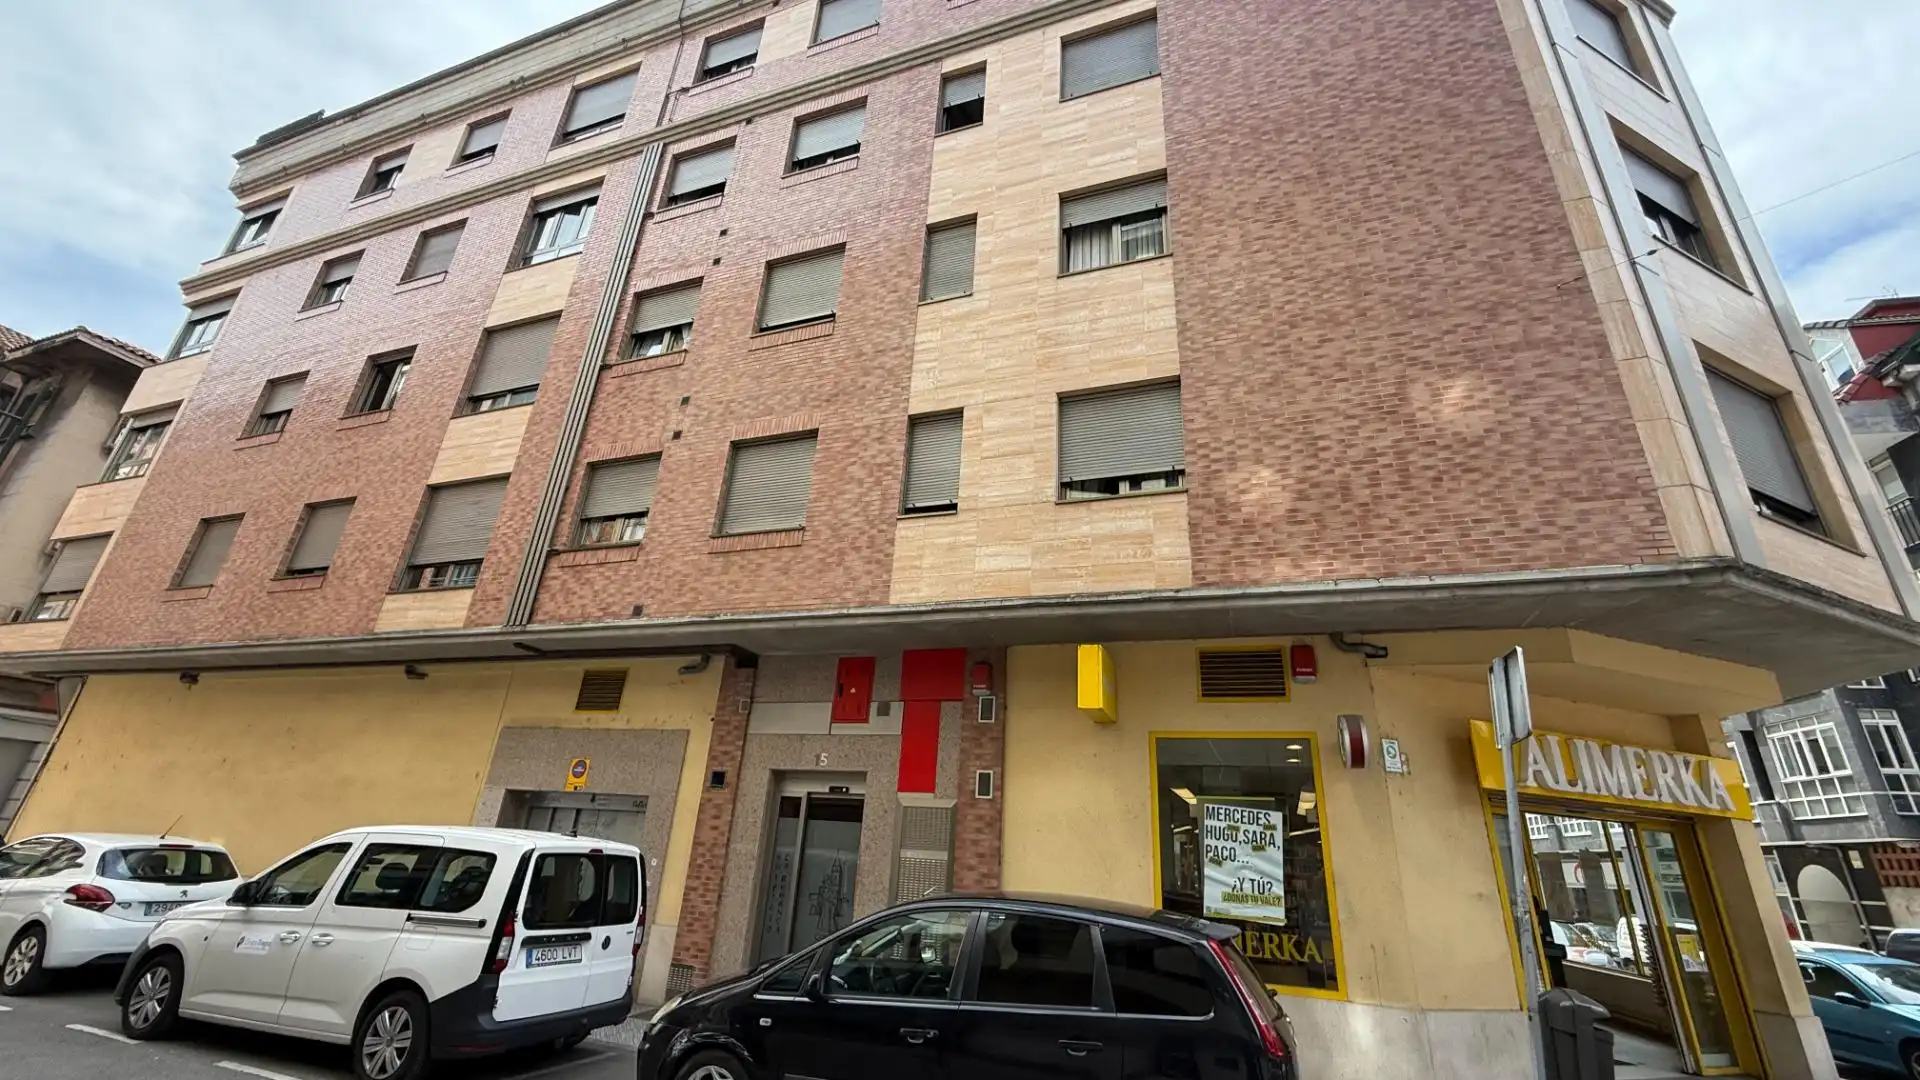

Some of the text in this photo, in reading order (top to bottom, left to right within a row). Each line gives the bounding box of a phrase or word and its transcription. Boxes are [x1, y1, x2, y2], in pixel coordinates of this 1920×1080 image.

[1527, 735, 1736, 812] ALIMERKA
[1248, 876, 1273, 896] TÚ?
[1259, 895, 1281, 907] VALE?
[535, 946, 578, 962] 4600 LVT
